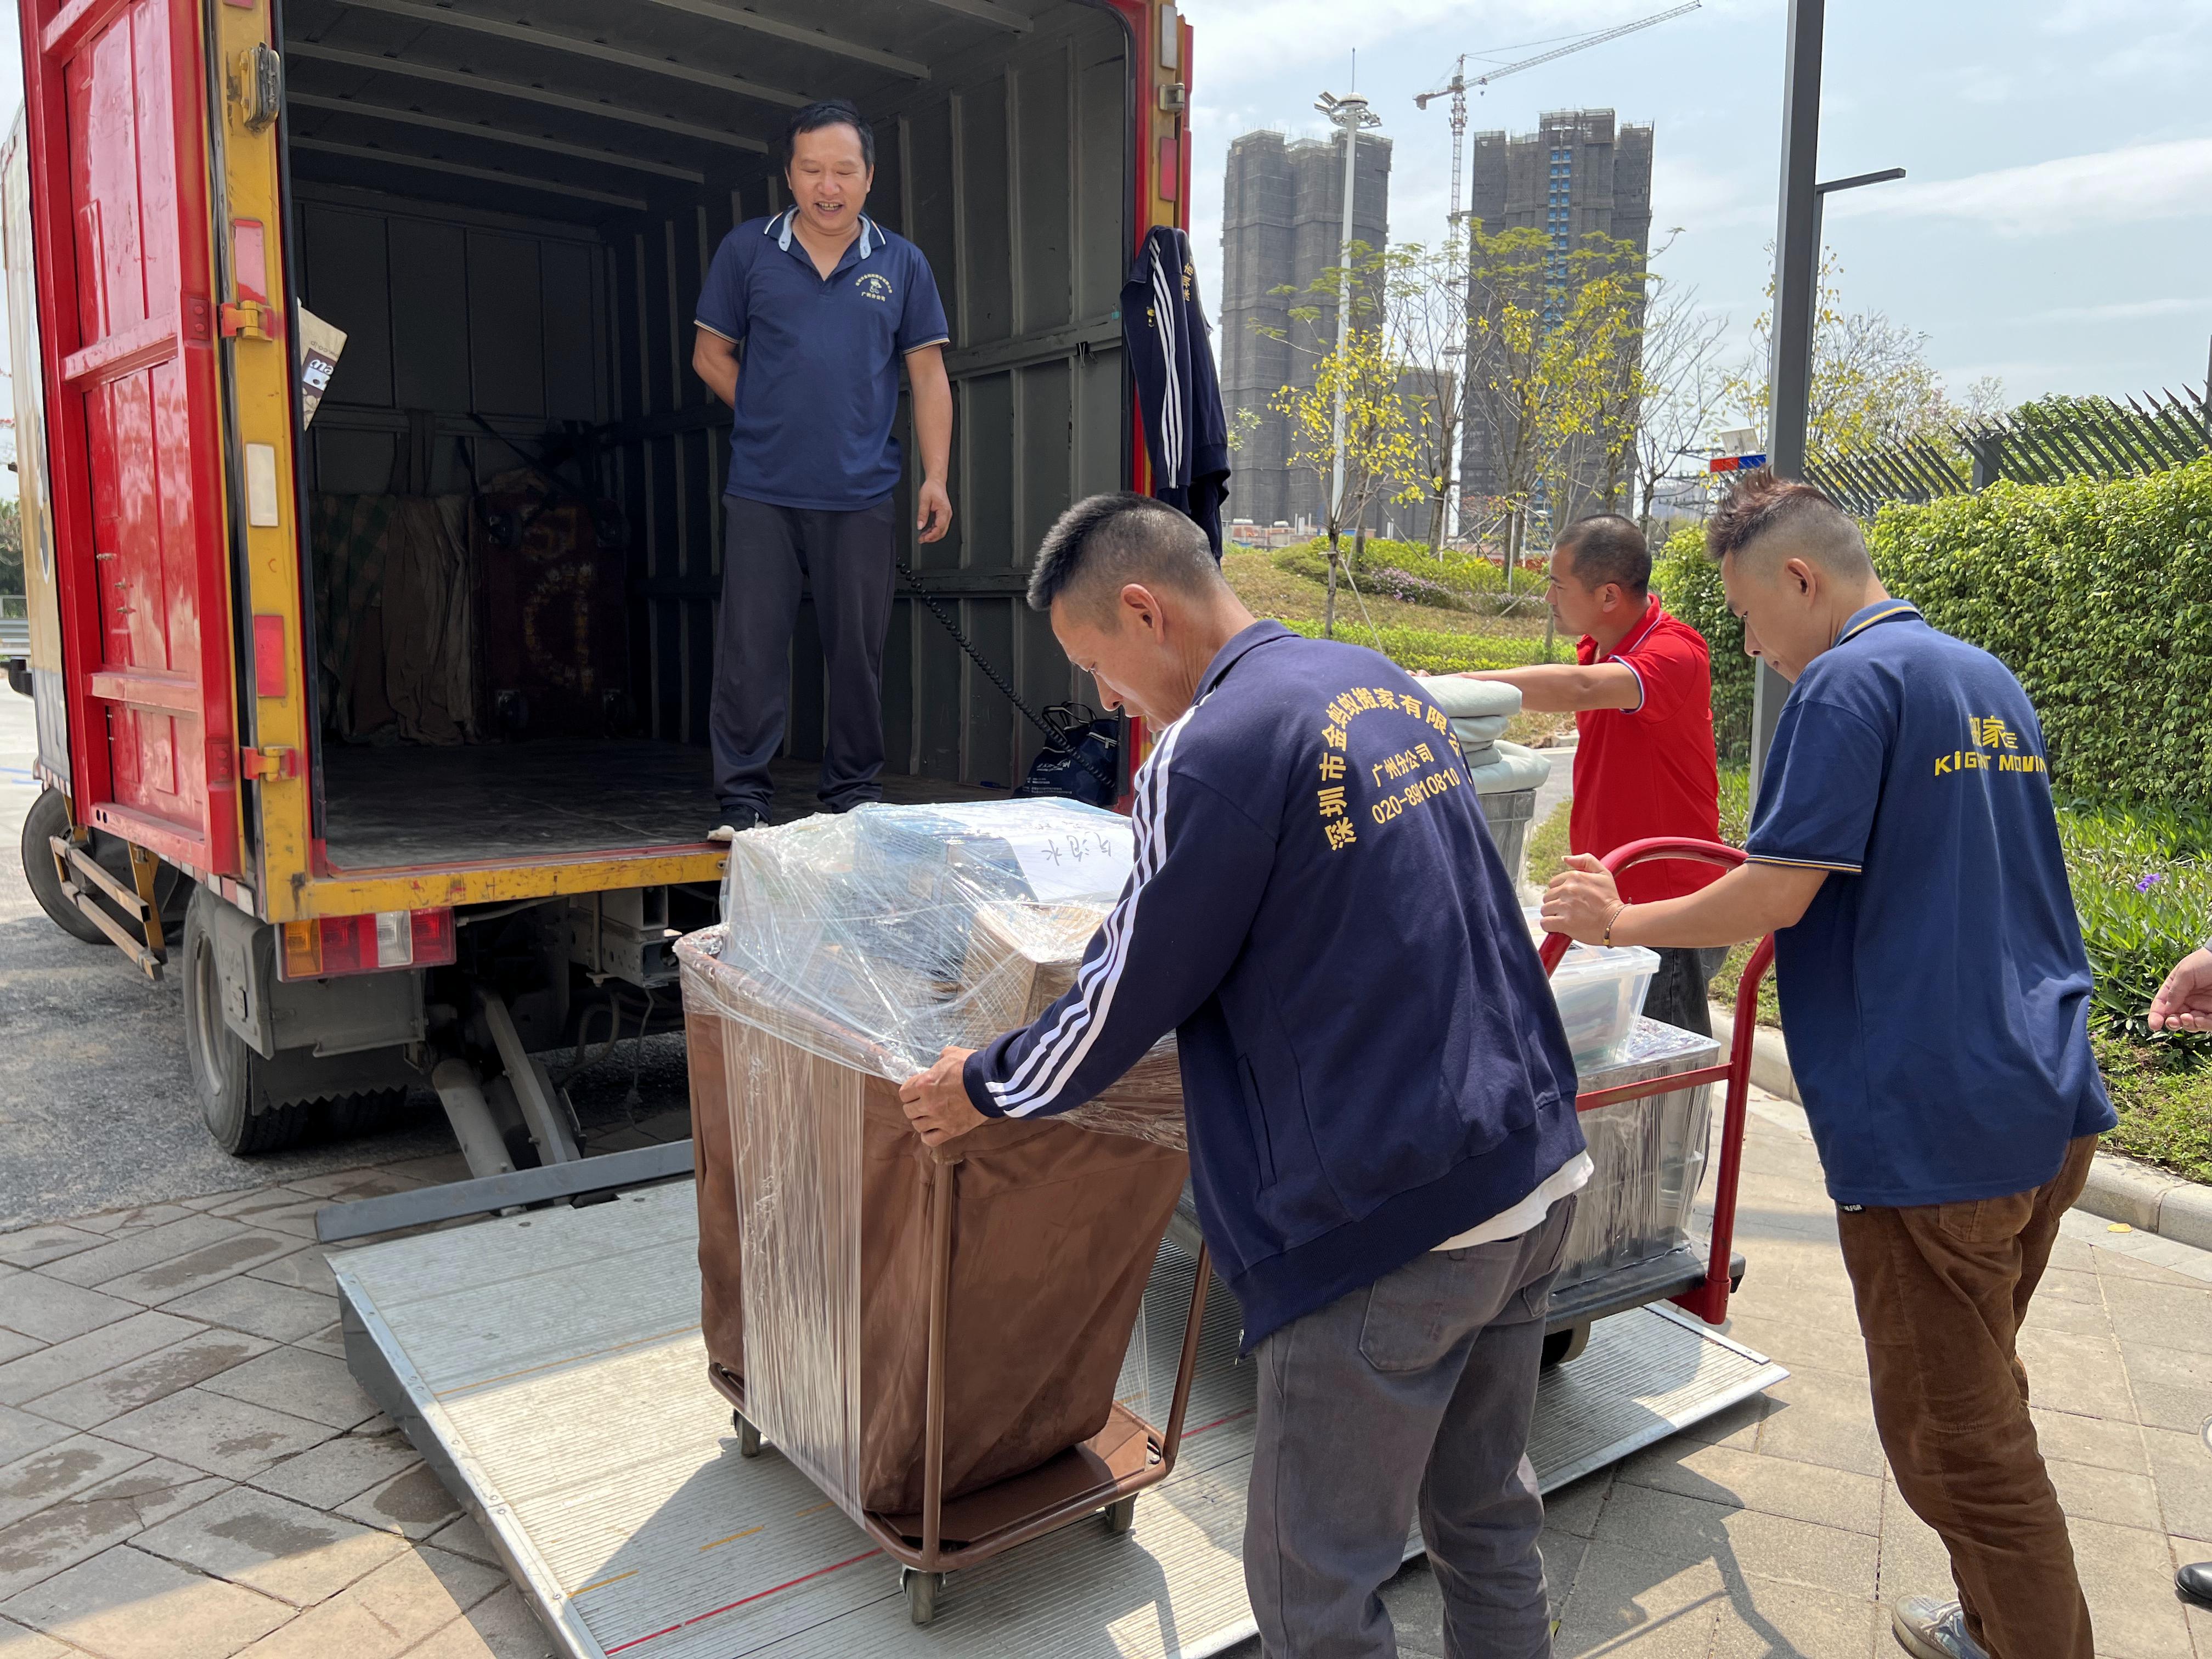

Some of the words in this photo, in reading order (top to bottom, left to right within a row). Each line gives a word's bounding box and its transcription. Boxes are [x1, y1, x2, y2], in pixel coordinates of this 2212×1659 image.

[1371, 742, 1435, 788] 广州分公司
